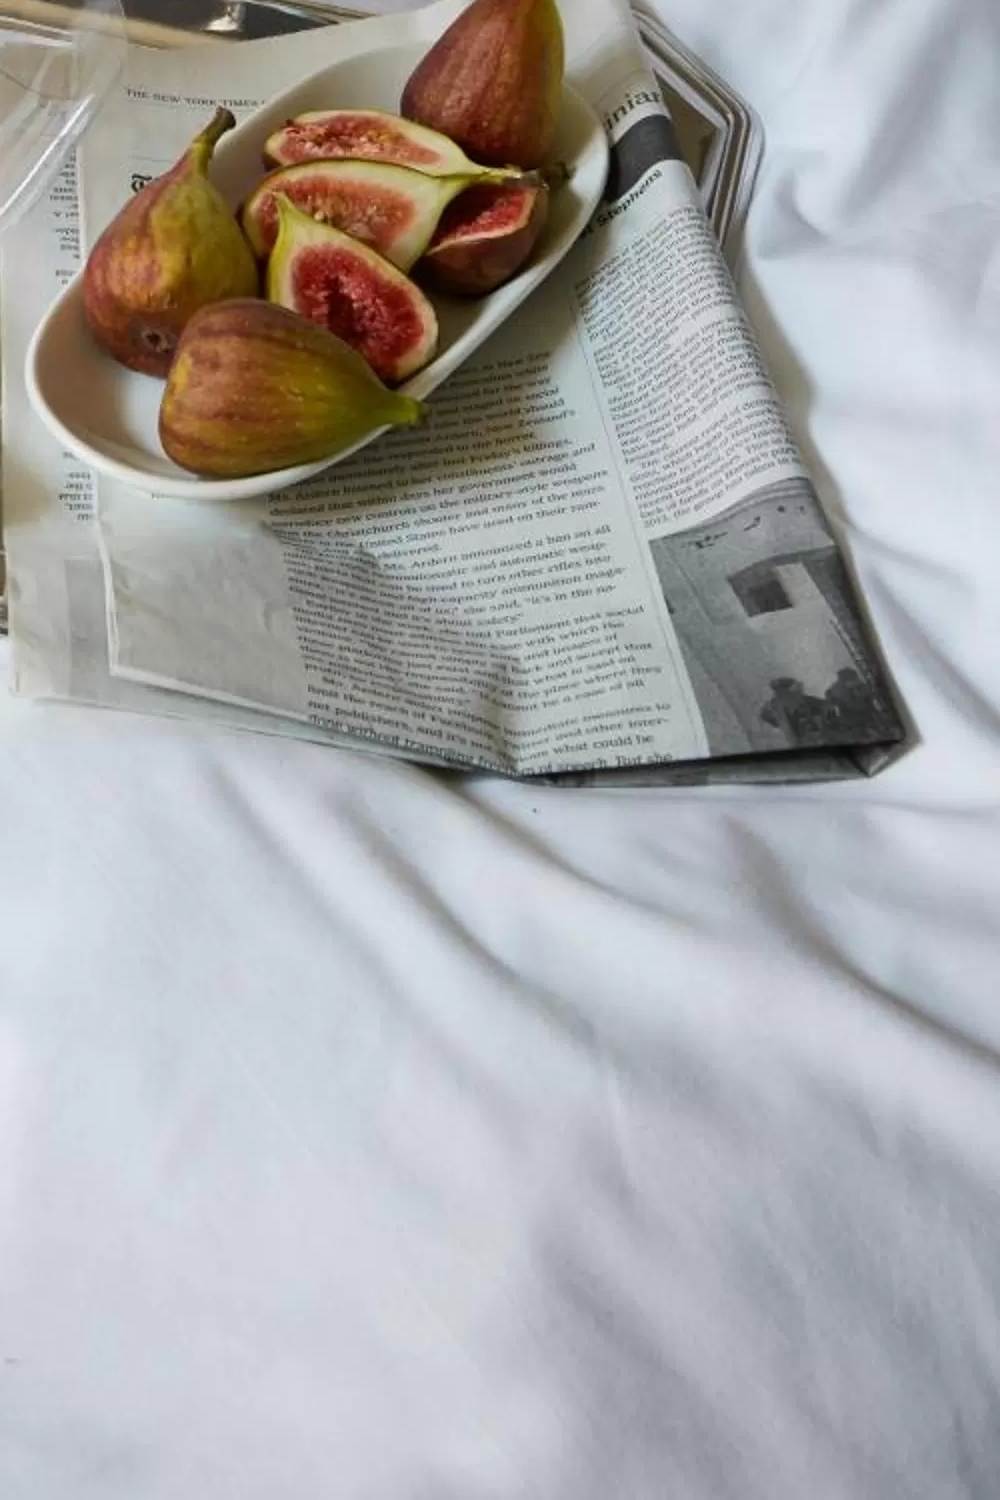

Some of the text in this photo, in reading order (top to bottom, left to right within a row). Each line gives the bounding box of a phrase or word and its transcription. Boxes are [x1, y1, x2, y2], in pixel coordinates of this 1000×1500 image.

[126, 87, 147, 100] THE
[152, 92, 180, 104] NEW
[185, 96, 217, 107] YORK
